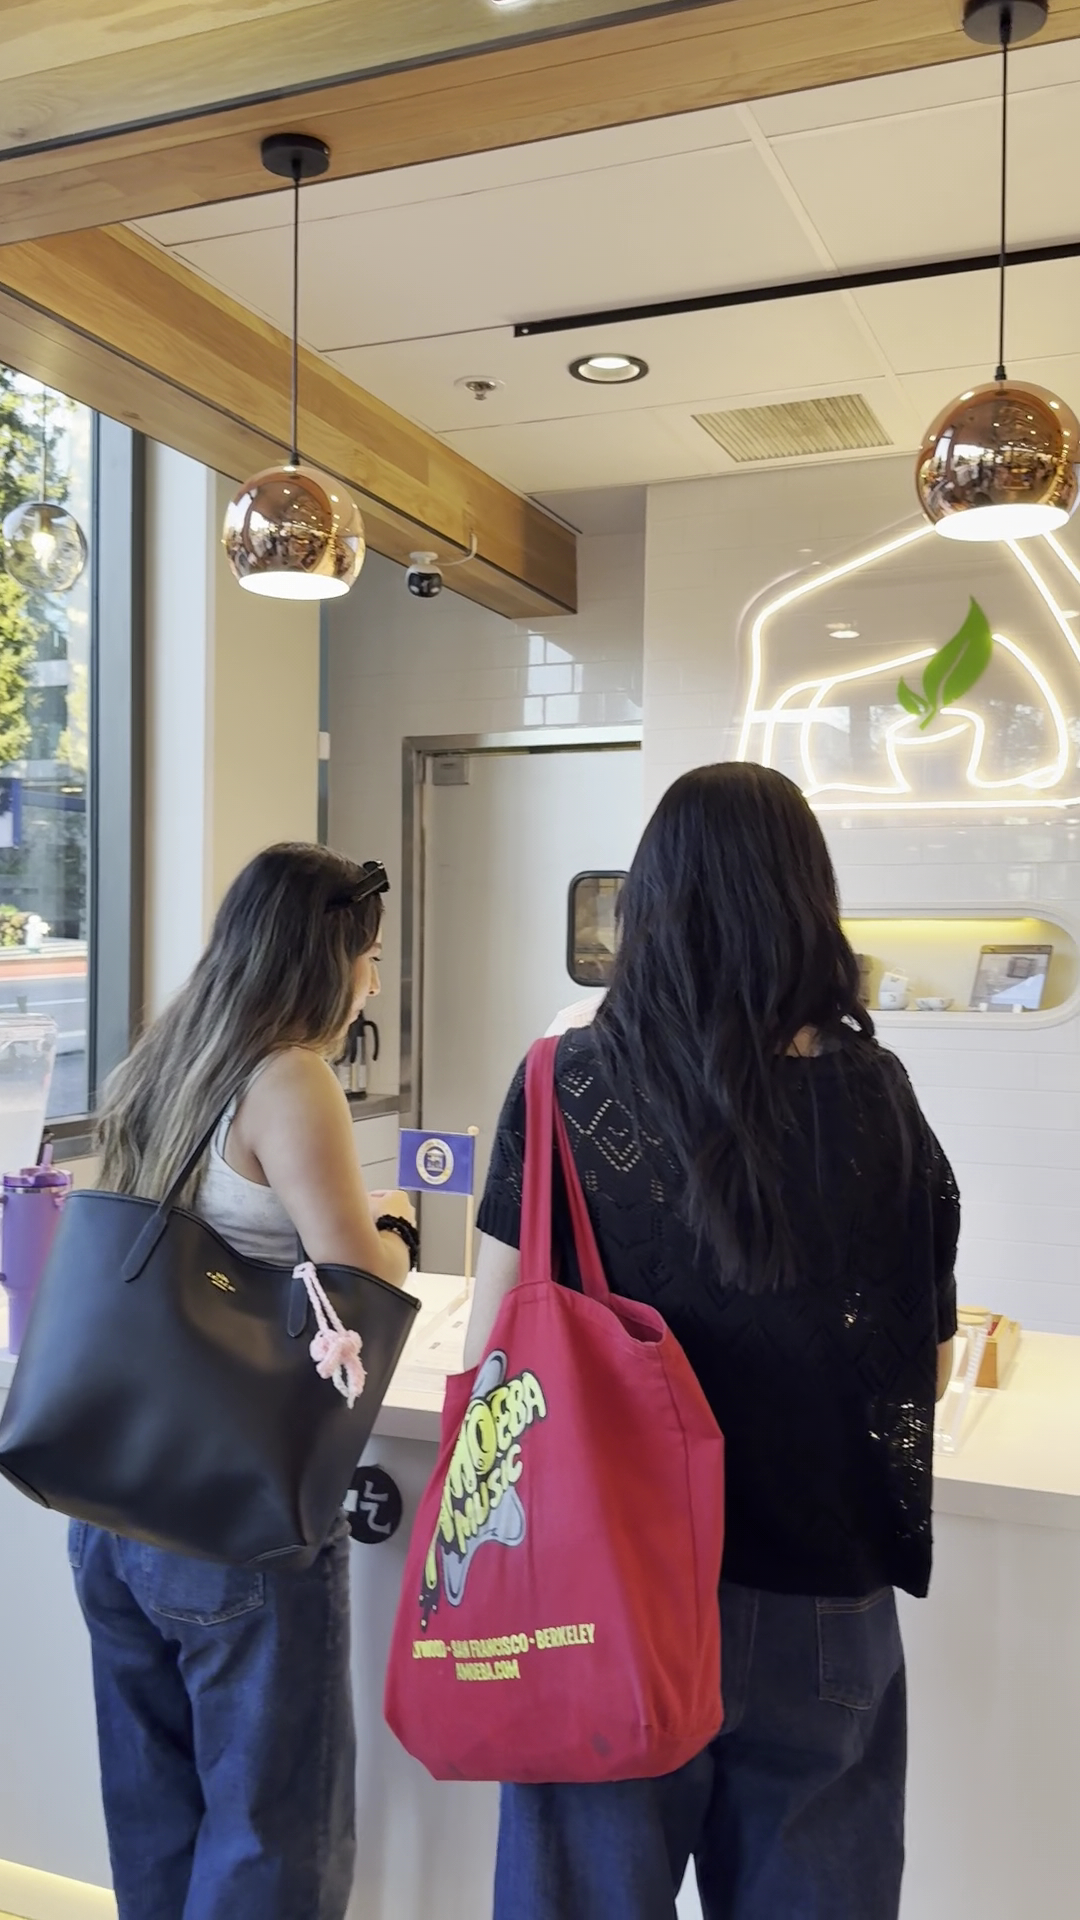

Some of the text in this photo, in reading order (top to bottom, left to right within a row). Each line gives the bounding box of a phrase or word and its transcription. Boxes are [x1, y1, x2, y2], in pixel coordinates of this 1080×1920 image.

[454, 1443, 523, 1554] MUSIC
[469, 1633, 530, 1658] FRANCISCO
[535, 1623, 596, 1650] BERKELEY
